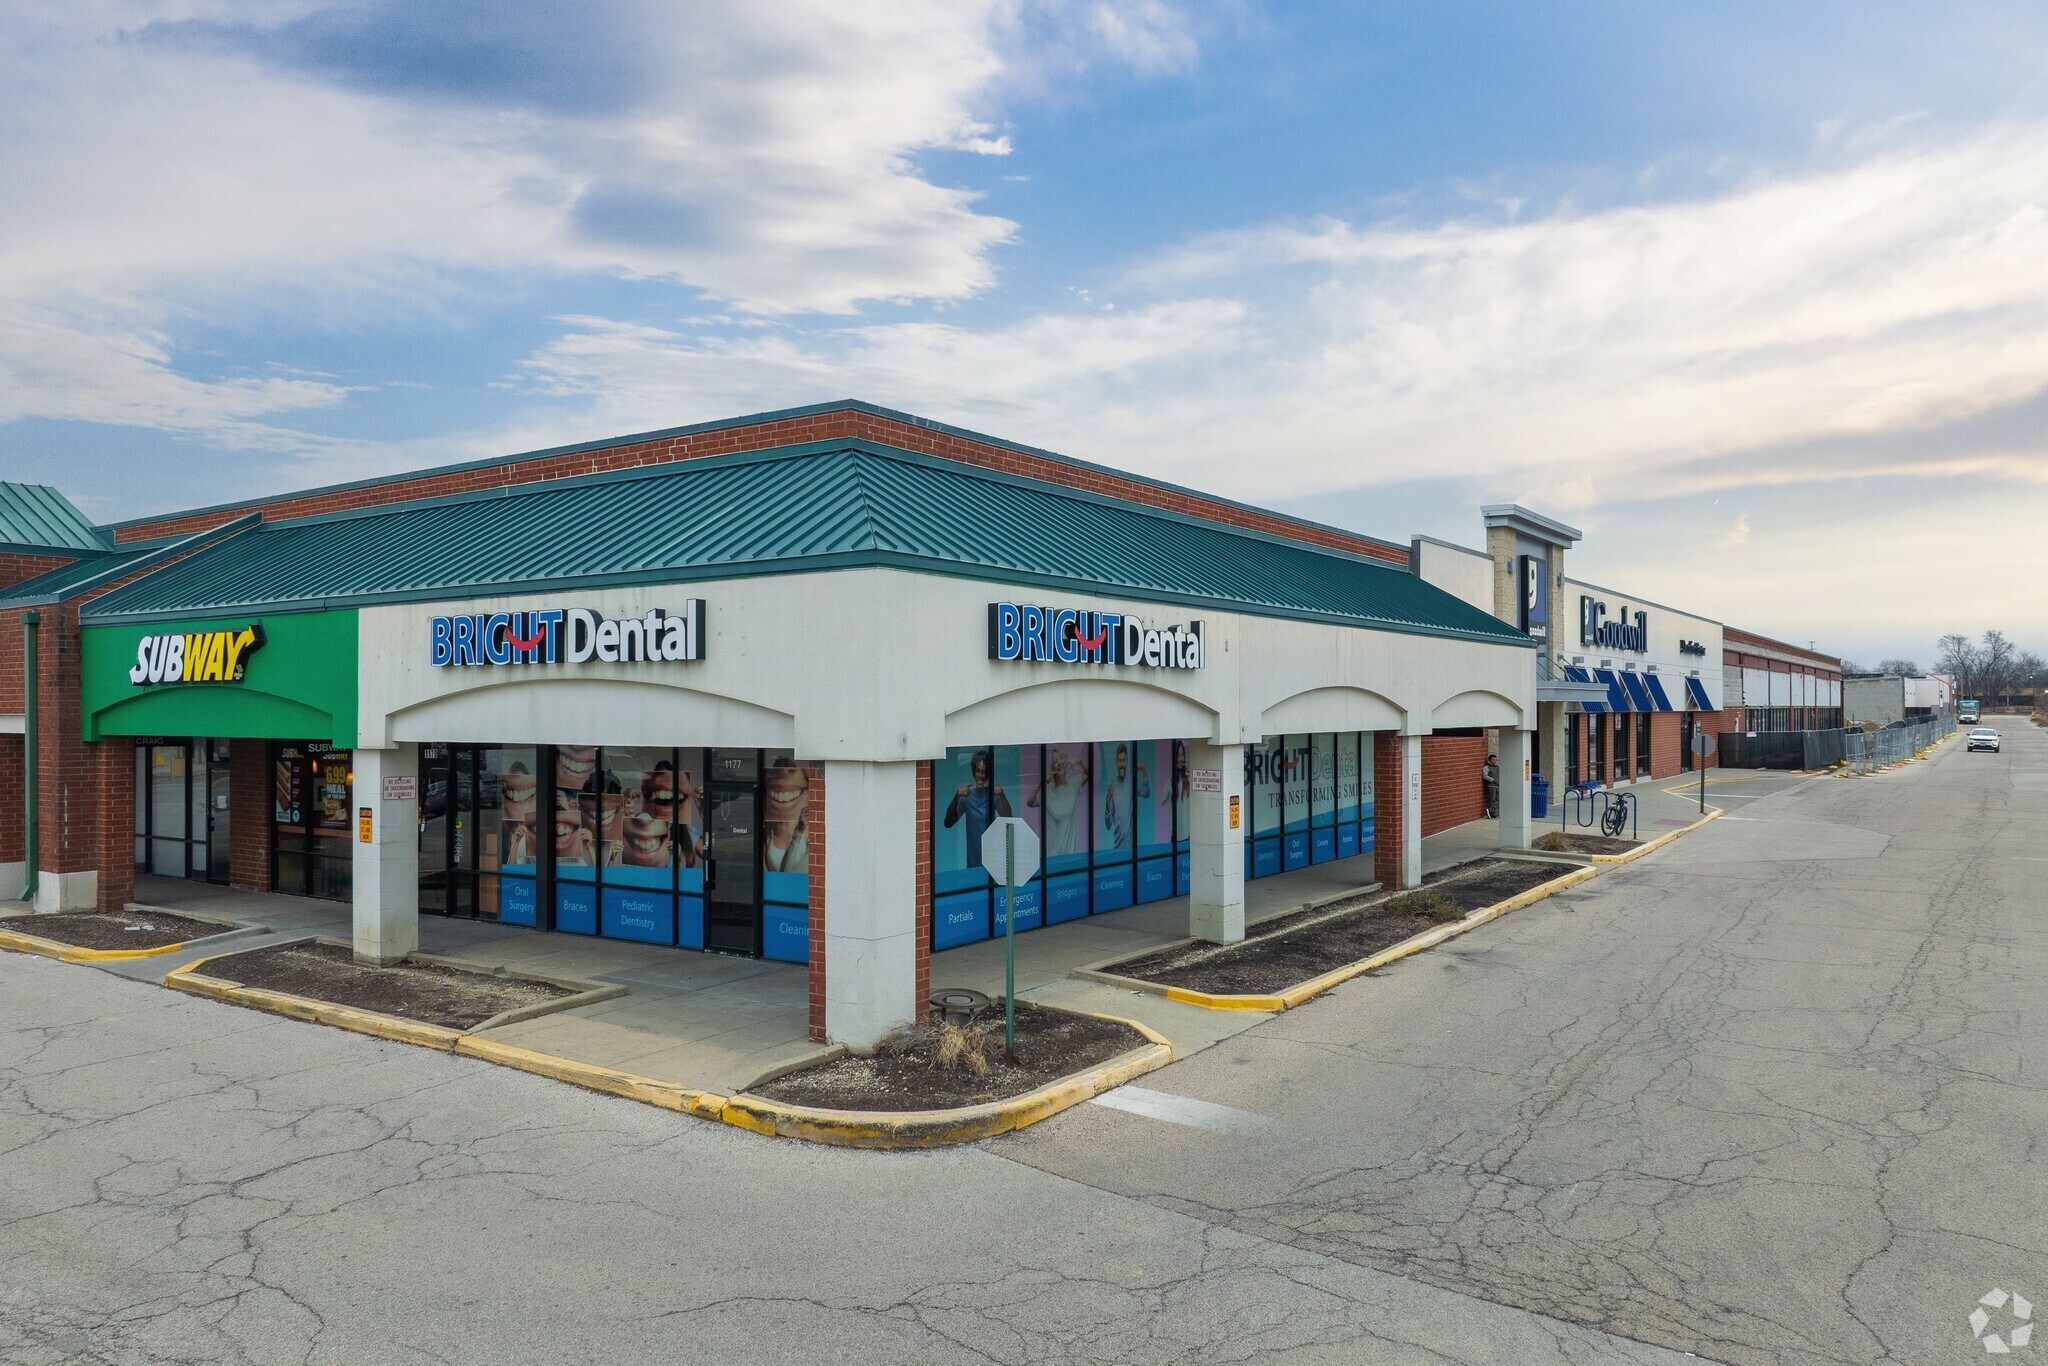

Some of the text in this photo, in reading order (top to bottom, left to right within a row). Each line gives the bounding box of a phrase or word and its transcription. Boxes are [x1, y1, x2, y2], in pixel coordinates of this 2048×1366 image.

[431, 598, 701, 667] BRIGHT Dental
[1594, 601, 1647, 653] Goodwill
[997, 602, 1205, 669] BRIGHT Dental
[129, 625, 256, 685] SUBWAY
[135, 737, 164, 745] CRAIG
[724, 759, 742, 769] 1177
[326, 784, 346, 794] MEAL
[1292, 840, 1300, 848] Oral
[1290, 850, 1302, 860] Surgery
[1146, 872, 1162, 882] Braces
[514, 886, 529, 897] Oral
[1100, 880, 1124, 890] Cleaning
[1000, 892, 1034, 907] Ergency
[1056, 887, 1078, 900] Bridges
[509, 900, 535, 914] Surgery
[563, 900, 588, 912] Braces
[622, 900, 654, 913] Pediatric
[621, 914, 655, 931] Dentistry
[948, 910, 974, 924] Partials
